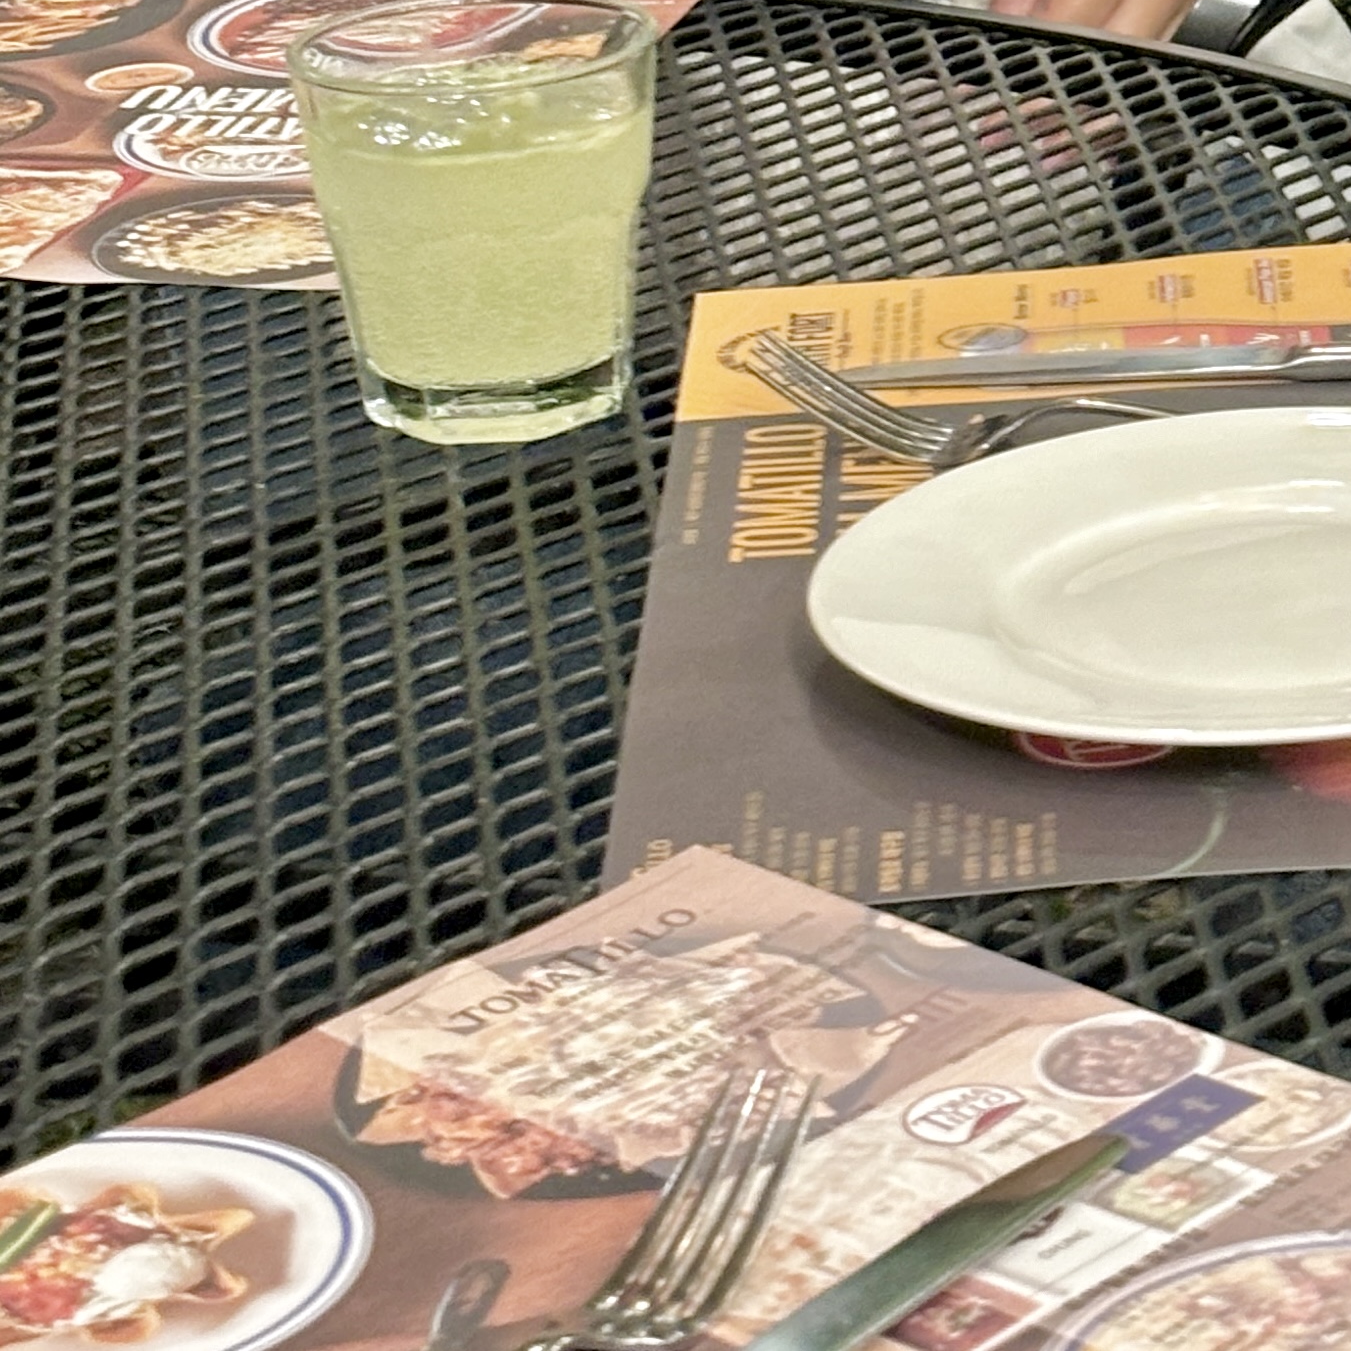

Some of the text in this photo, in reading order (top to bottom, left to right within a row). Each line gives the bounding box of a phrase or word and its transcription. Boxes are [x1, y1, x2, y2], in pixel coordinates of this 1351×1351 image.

[122, 112, 301, 139] ATILLO
[729, 424, 827, 563] TOMATILLO
[449, 907, 698, 1035] TOMATILLO
